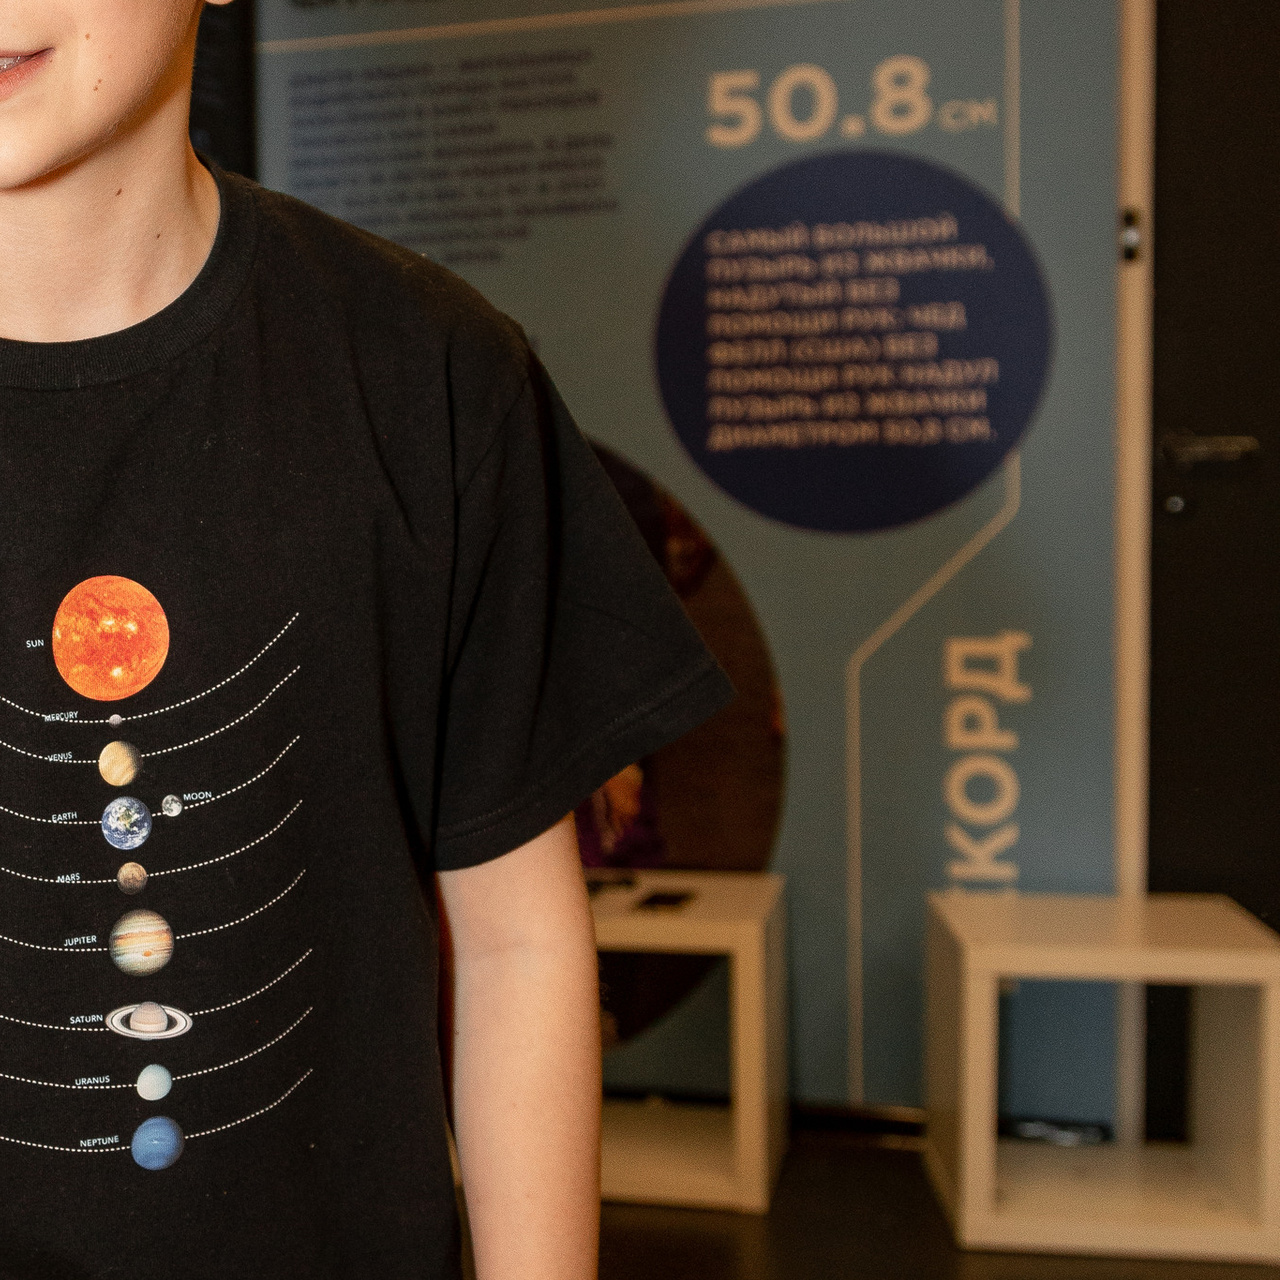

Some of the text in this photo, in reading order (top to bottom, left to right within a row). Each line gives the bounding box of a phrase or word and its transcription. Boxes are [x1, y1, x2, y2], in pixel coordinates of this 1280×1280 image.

[705, 55, 934, 150] 50.8
[707, 211, 958, 254] САМЫЙ БОЛЬШОЙ
[26, 639, 45, 649] SUN
[44, 710, 79, 722] MERCURY
[47, 750, 73, 762] VENUS
[943, 631, 1033, 890] КОРД
[183, 790, 213, 802] MOON
[51, 810, 78, 823] EARTH
[57, 873, 81, 884] MARS
[63, 934, 97, 947] JUPITER
[69, 1013, 104, 1025] SATURN
[74, 1075, 110, 1087] URANUS
[79, 1135, 120, 1148] NEPTUNE
